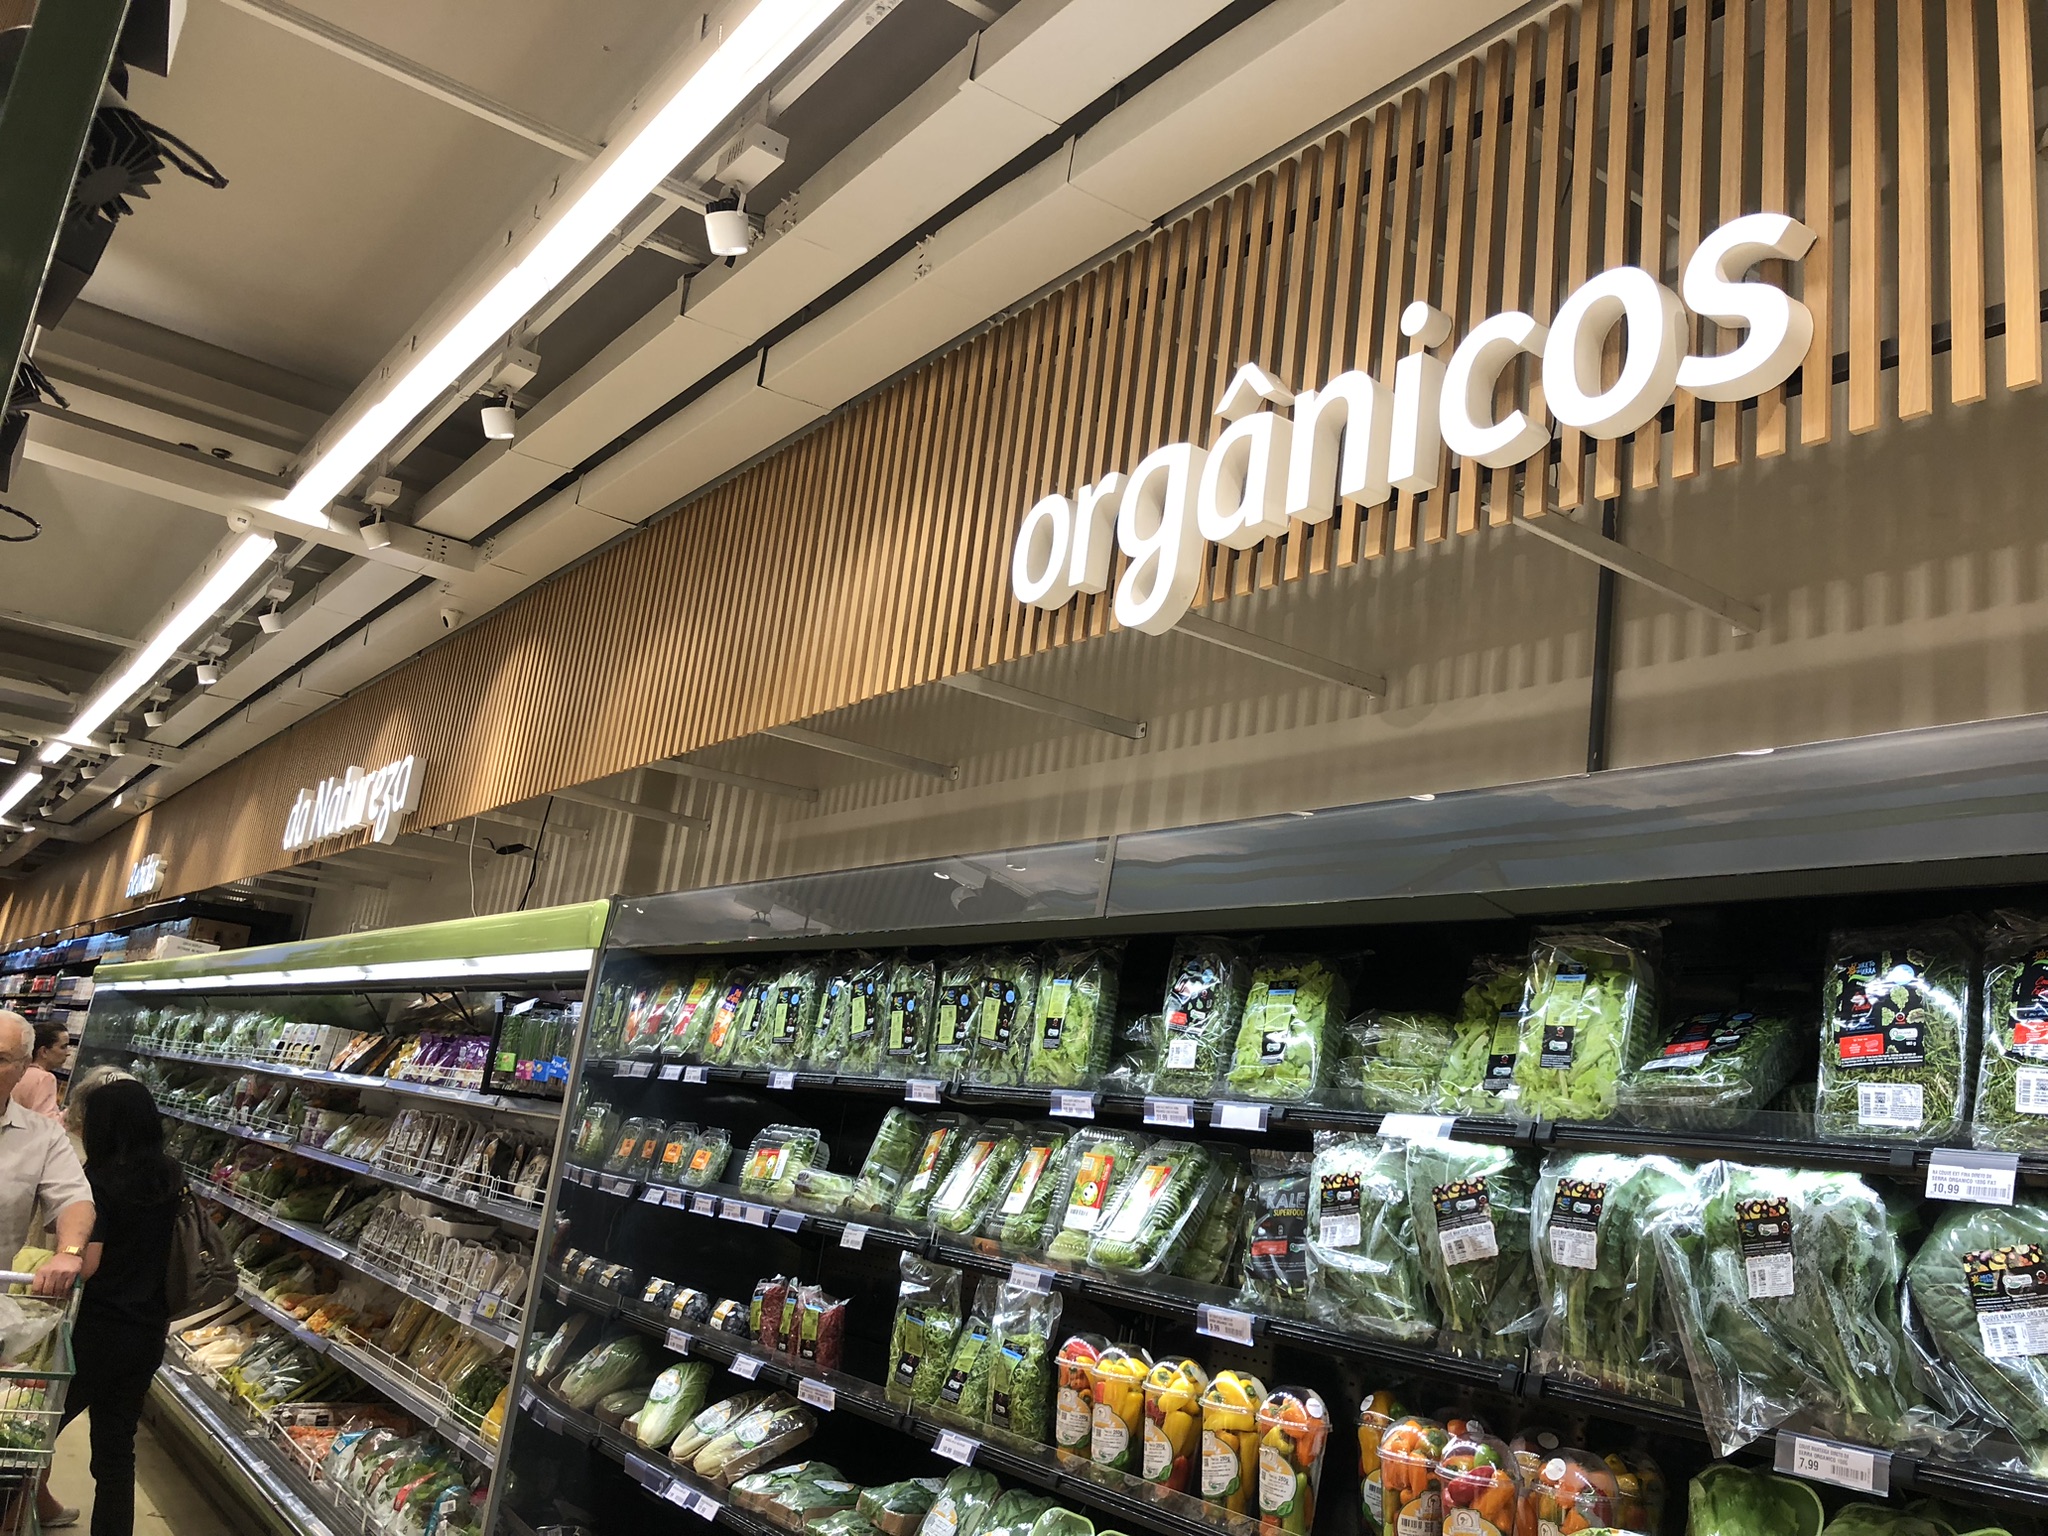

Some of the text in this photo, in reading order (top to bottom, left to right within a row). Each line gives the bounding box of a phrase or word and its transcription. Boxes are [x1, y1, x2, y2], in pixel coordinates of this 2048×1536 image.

[1012, 212, 1816, 634] orgânicos
[283, 754, 418, 850] da Natureza
[1932, 1183, 1960, 1195] 10,99
[1266, 1191, 1306, 1209] KALE
[1273, 1208, 1306, 1217] SUPERFOOD
[1798, 1457, 1819, 1471] 7,99
